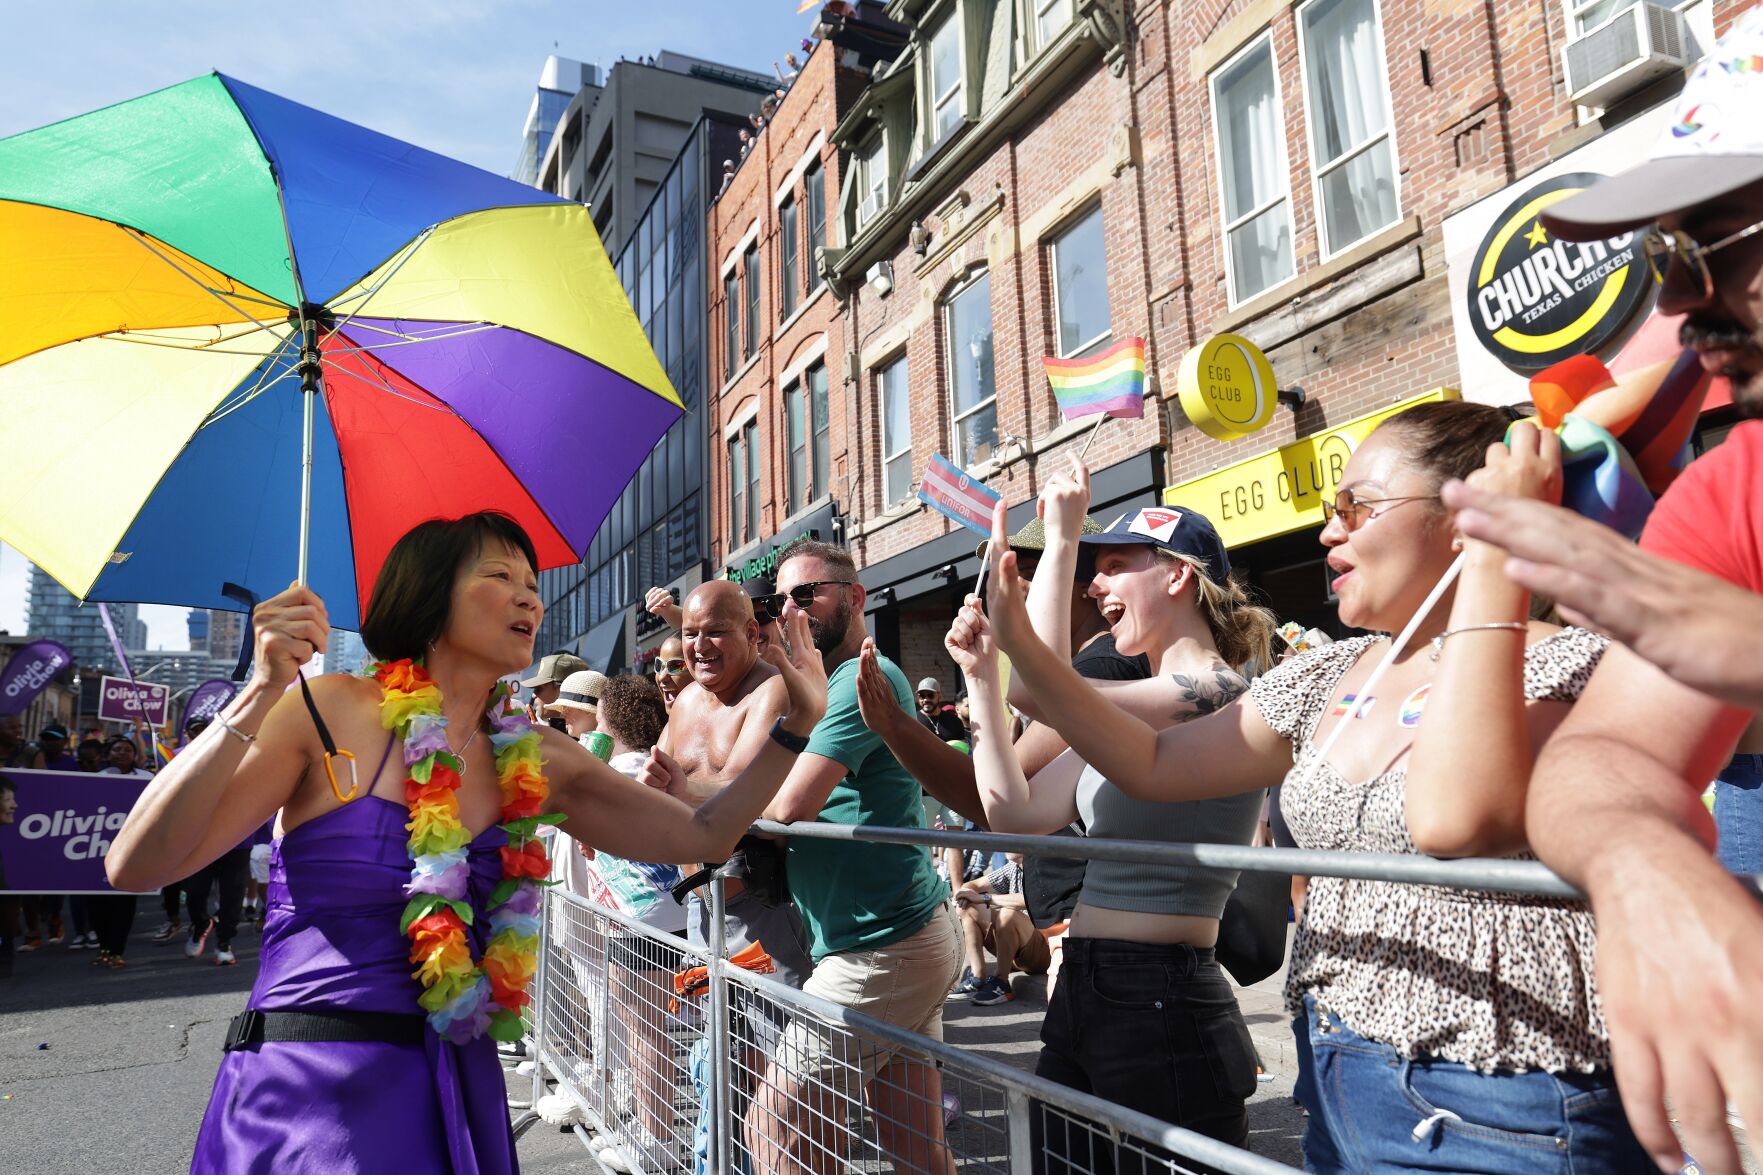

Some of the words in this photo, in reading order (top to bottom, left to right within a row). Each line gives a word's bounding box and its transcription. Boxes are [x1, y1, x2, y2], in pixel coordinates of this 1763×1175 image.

[1477, 231, 1635, 331] CHURCH
[1521, 292, 1562, 325] TEXAS
[1574, 248, 1635, 292] CHICKEN
[1208, 364, 1232, 382] EGG
[1210, 384, 1242, 402] CLUB
[1220, 479, 1264, 521] EGG
[1277, 453, 1344, 503] CLUB
[729, 568, 742, 585] the
[741, 554, 767, 581] village
[5, 659, 43, 697] Olivia
[106, 686, 148, 700] Olivia
[19, 805, 128, 839] Olivia
[63, 831, 111, 860] Ch
